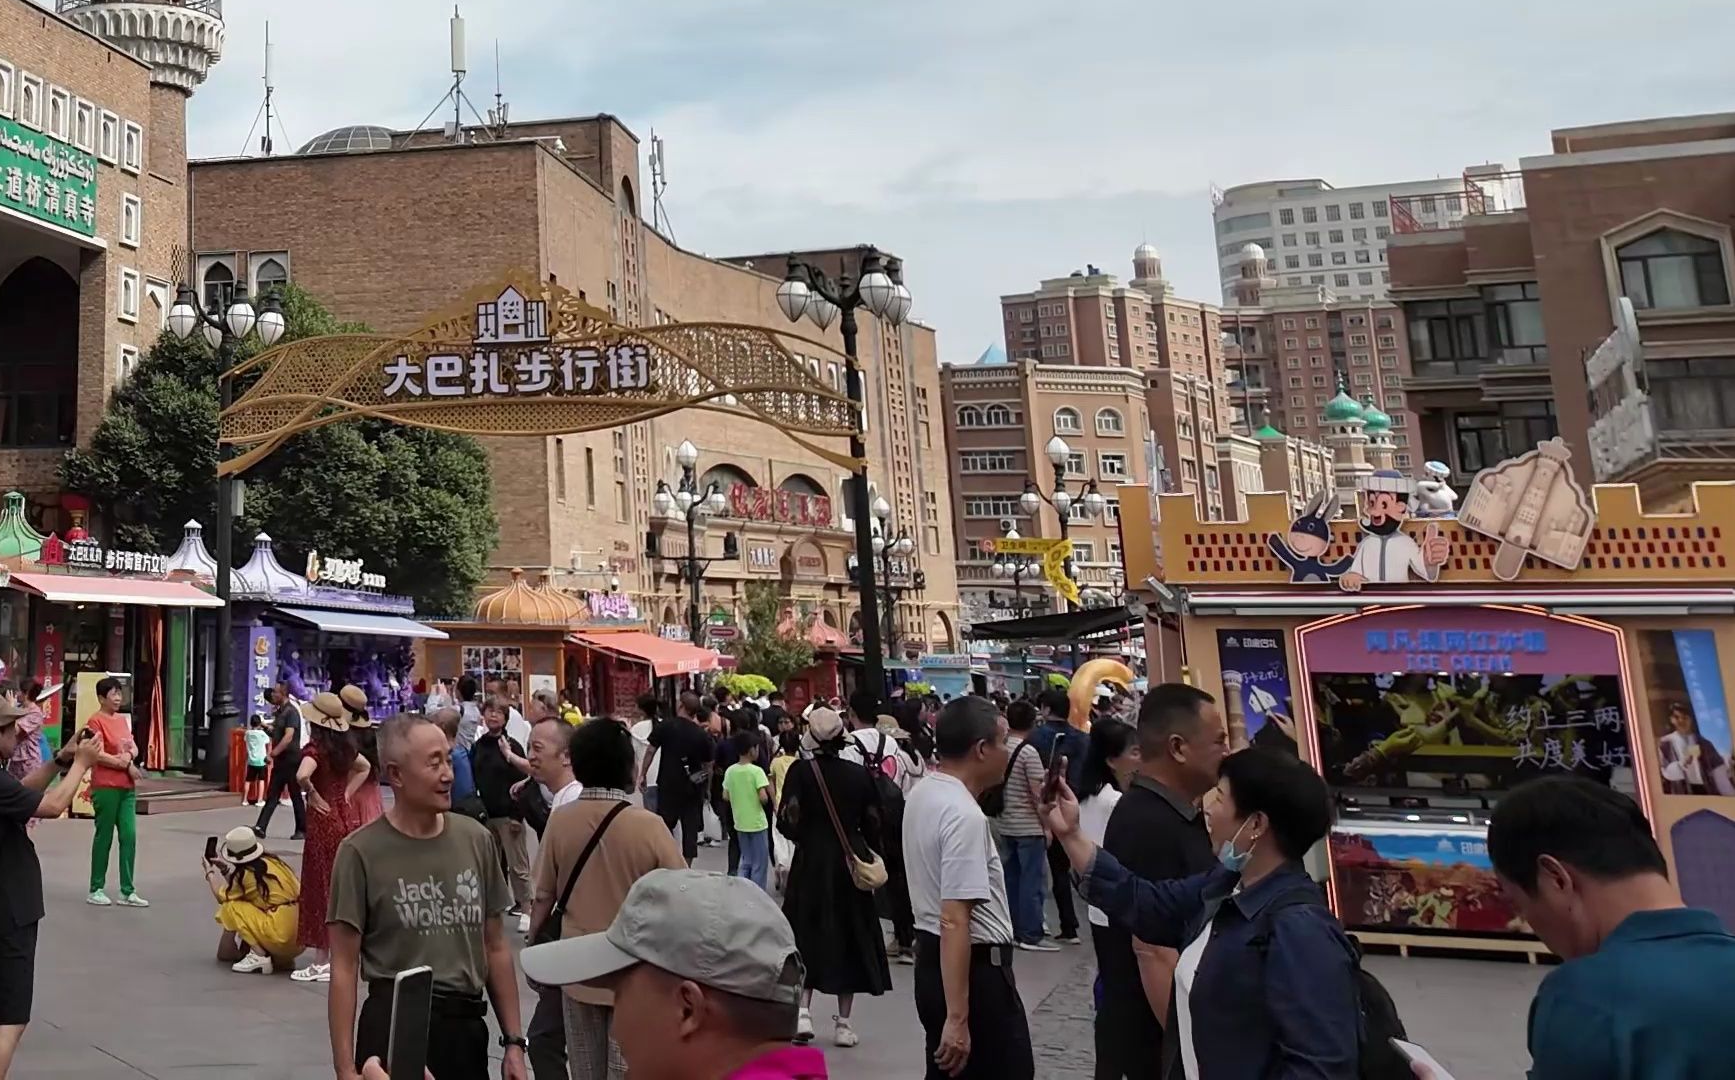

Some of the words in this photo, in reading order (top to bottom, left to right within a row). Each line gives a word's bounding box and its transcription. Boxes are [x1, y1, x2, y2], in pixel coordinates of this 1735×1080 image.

[383, 346, 649, 397] 大巴扎步行街
[1407, 654, 1440, 670] ICE
[1450, 654, 1513, 671] CREAM
[1511, 738, 1631, 771] 共度美好
[393, 874, 445, 904] Jack
[394, 898, 482, 928] Wolfskin
